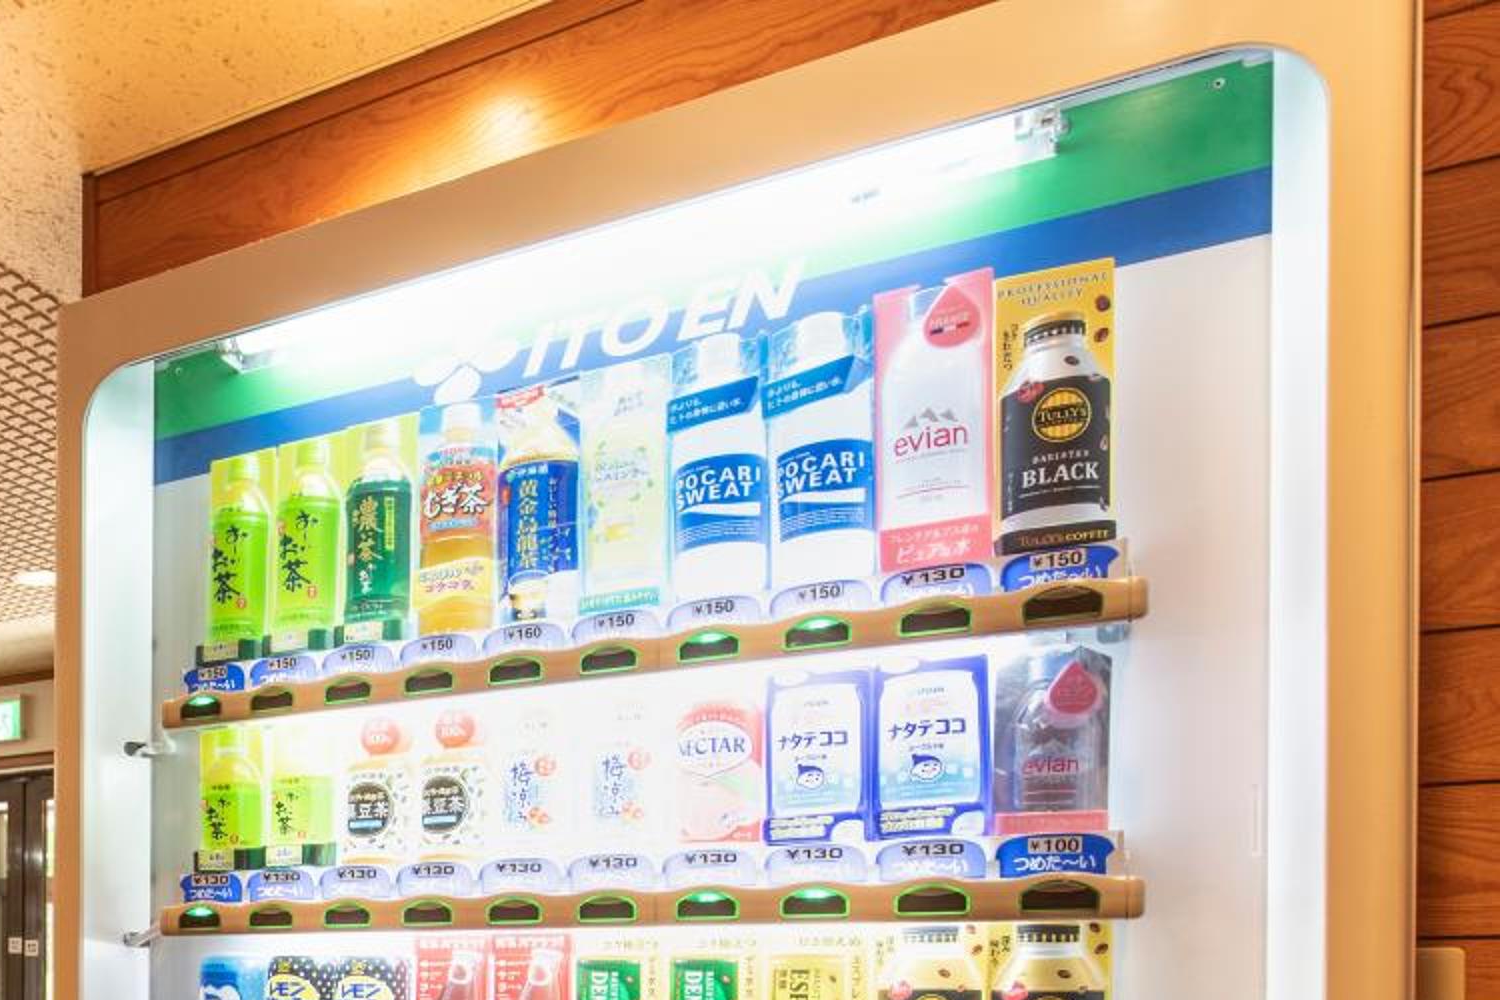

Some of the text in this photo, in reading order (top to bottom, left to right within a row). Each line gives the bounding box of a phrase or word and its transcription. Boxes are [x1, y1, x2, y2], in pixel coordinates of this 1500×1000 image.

[677, 255, 807, 341] EN
[893, 422, 969, 458] evian
[776, 450, 866, 484] POCARI
[676, 465, 762, 493] POCARI
[1021, 461, 1099, 490] BLACK
[776, 467, 857, 502] SWEAT
[675, 481, 754, 511] SWEAT
[1033, 552, 1085, 568] ¥150
[900, 566, 965, 586] ¥130
[798, 584, 841, 601] ¥150
[694, 600, 735, 616] ¥150
[597, 612, 635, 628] ¥150
[421, 638, 453, 651] ¥150
[339, 649, 371, 661] ¥150
[268, 658, 297, 670] ¥150
[888, 716, 966, 741] ナタデココ
[777, 728, 848, 752] ナタデココ
[1021, 757, 1080, 776] evian
[901, 842, 965, 856] ¥130
[1029, 838, 1080, 853] ¥100
[684, 852, 737, 866] ¥130
[786, 847, 843, 861] ¥130
[411, 864, 455, 877] ¥130
[496, 861, 542, 874] ¥130
[588, 856, 638, 870] ¥130
[337, 867, 377, 880] ¥130
[268, 981, 304, 996] レモン
[341, 982, 381, 998] レモン
